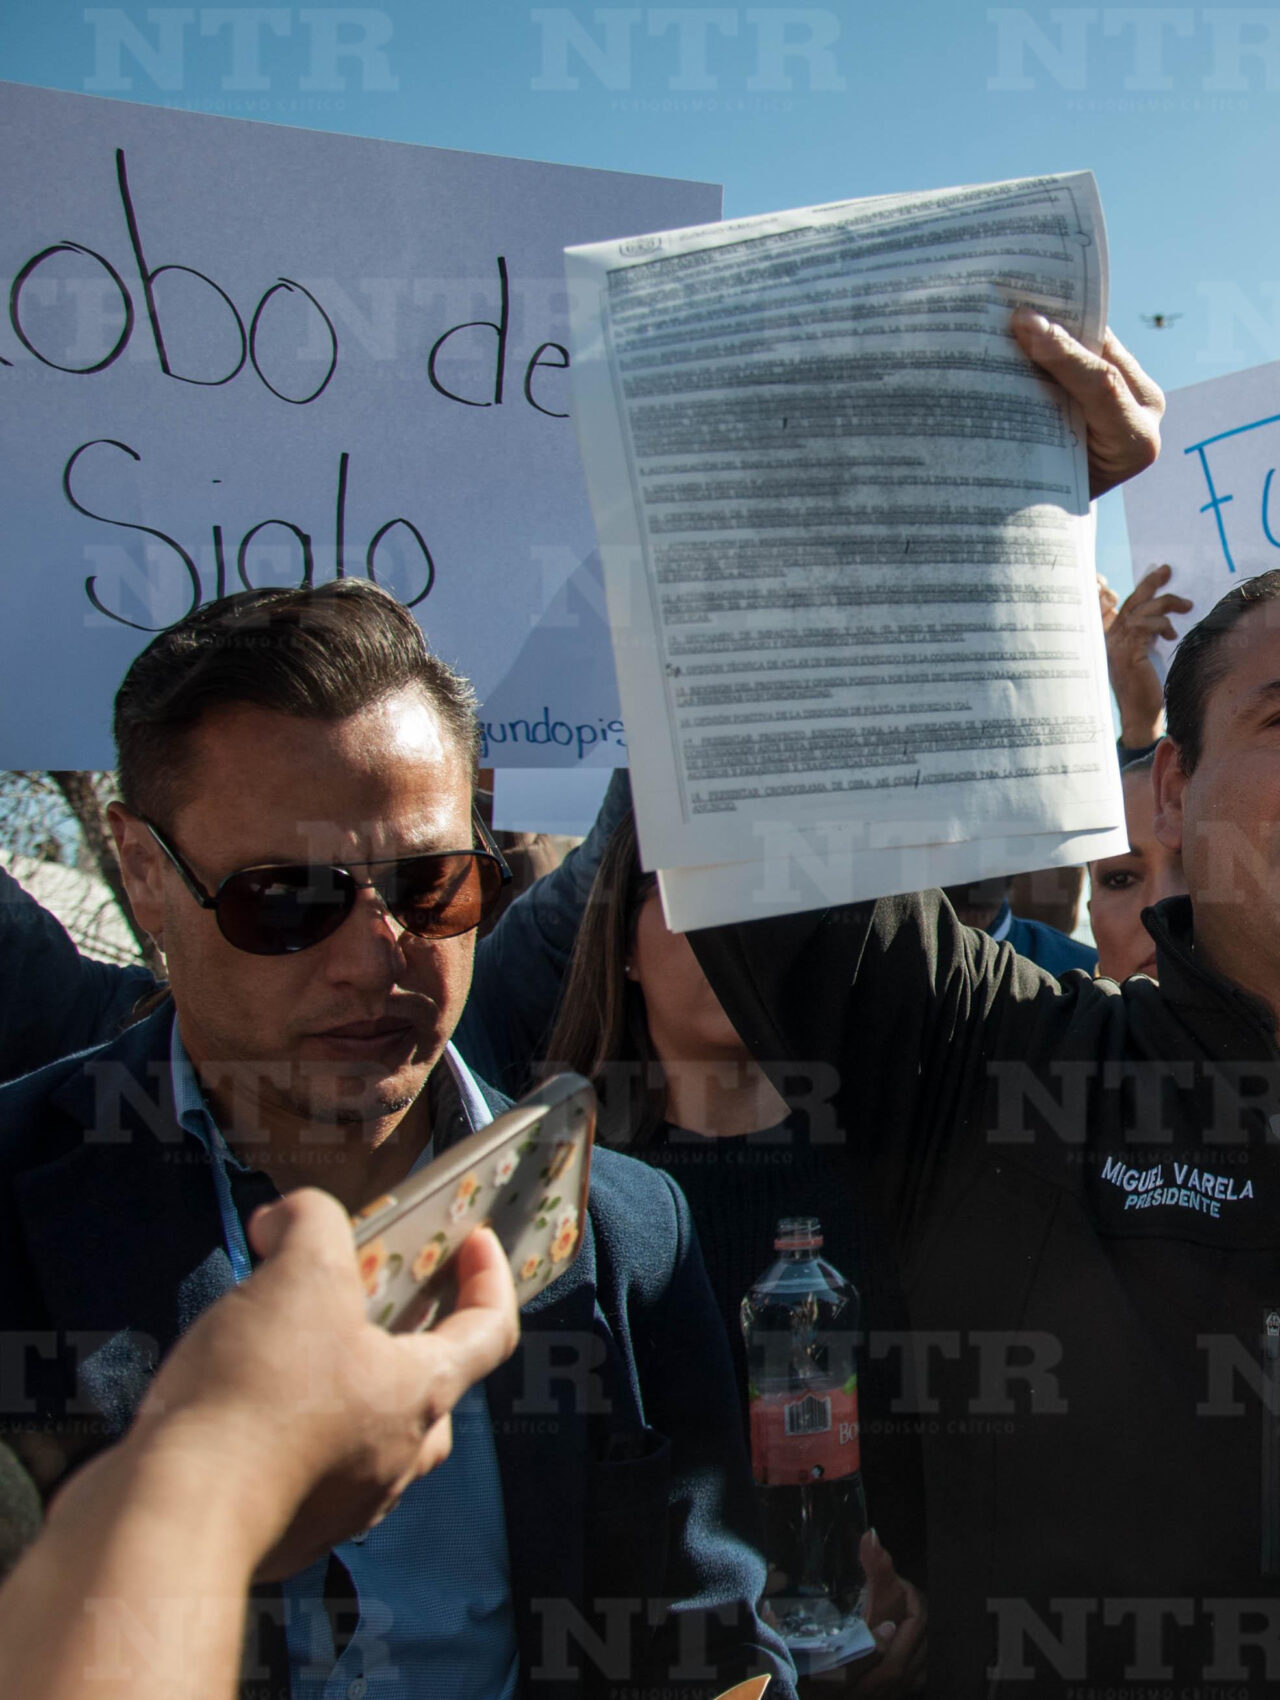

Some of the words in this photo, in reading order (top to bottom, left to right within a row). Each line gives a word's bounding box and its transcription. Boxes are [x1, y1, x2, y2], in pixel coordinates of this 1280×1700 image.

[0, 148, 337, 404] obo
[1101, 1156, 1164, 1192] MIGUEL
[1173, 1162, 1254, 1200] VARELA
[1124, 1187, 1221, 1218] PRESIDENTE
